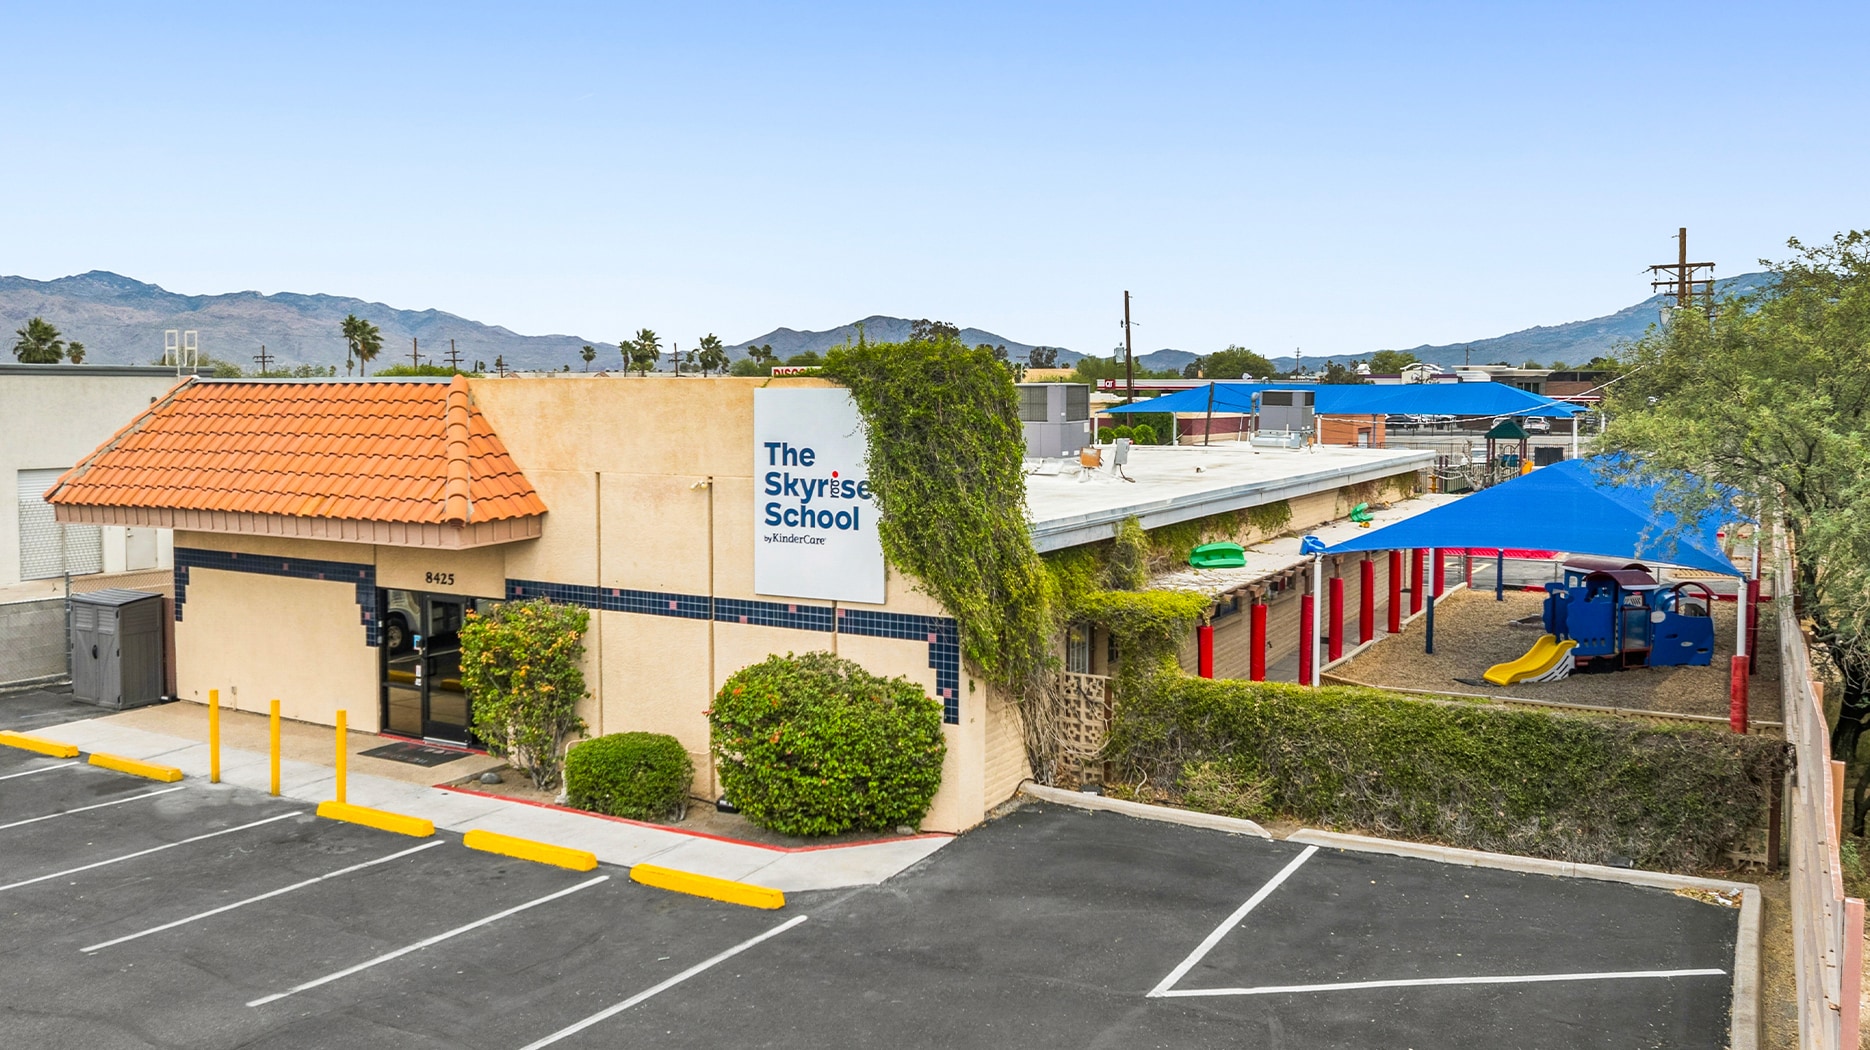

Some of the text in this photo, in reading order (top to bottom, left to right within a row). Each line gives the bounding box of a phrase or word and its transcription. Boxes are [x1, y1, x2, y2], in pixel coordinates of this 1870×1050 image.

[764, 442, 815, 466] The
[765, 471, 873, 504] Skyrise
[764, 502, 859, 530] School
[764, 533, 825, 545] by KinderCare
[425, 571, 455, 586] 8425
